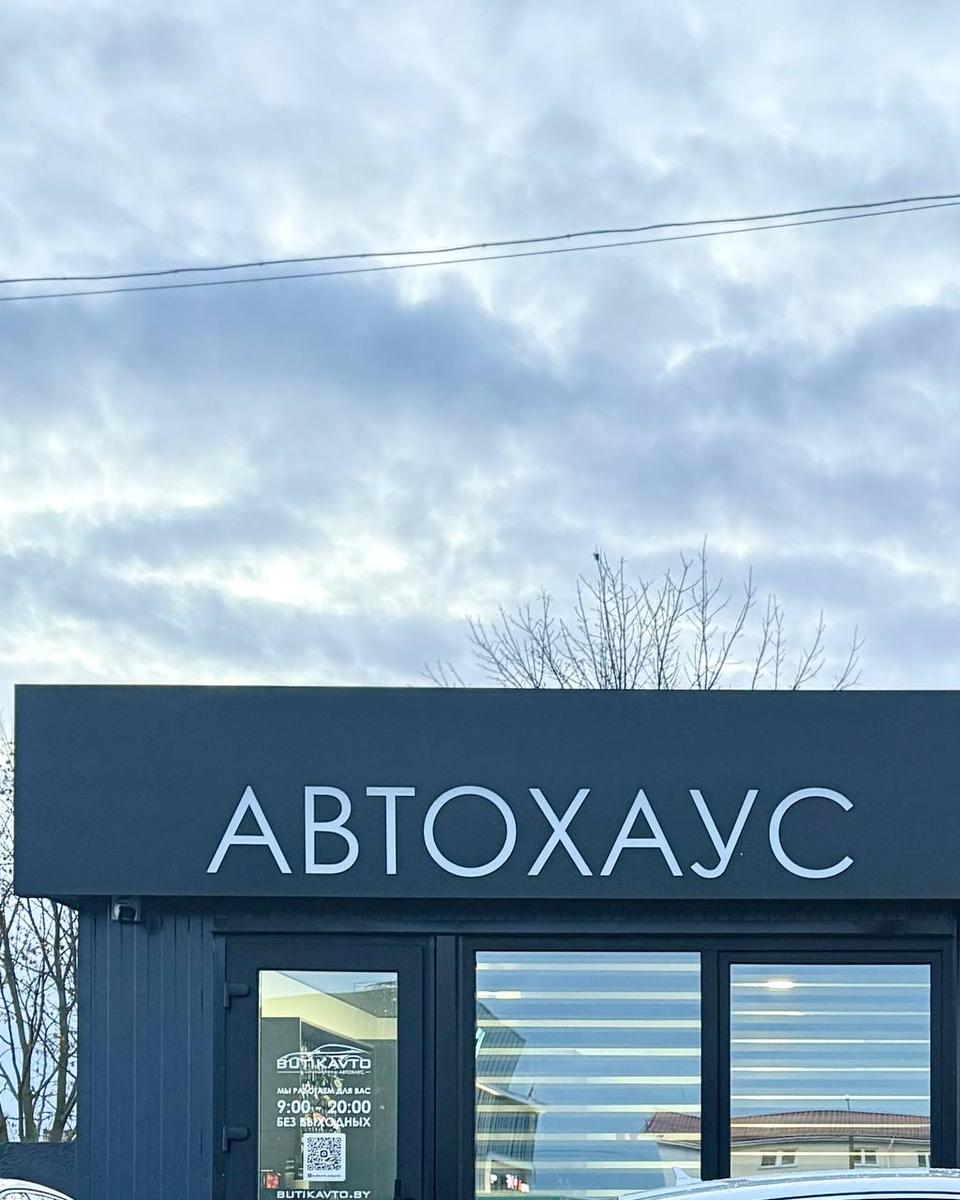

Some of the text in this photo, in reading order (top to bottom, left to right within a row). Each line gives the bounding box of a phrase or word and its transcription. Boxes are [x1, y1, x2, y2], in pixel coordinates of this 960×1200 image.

[207, 785, 855, 879] АВТОХАУС
[277, 1058, 371, 1069] BUTIKAVTO
[277, 1087, 291, 1095] МЫ
[335, 1087, 353, 1096] ДЛЯ
[354, 1087, 371, 1095] ВАС
[277, 1100, 311, 1114] 9:00
[328, 1100, 371, 1114] 20:00
[277, 1117, 371, 1128] БЕЗ ВЫХОДНЫХ
[277, 1190, 371, 1199] BUTIKAVTO.BY
